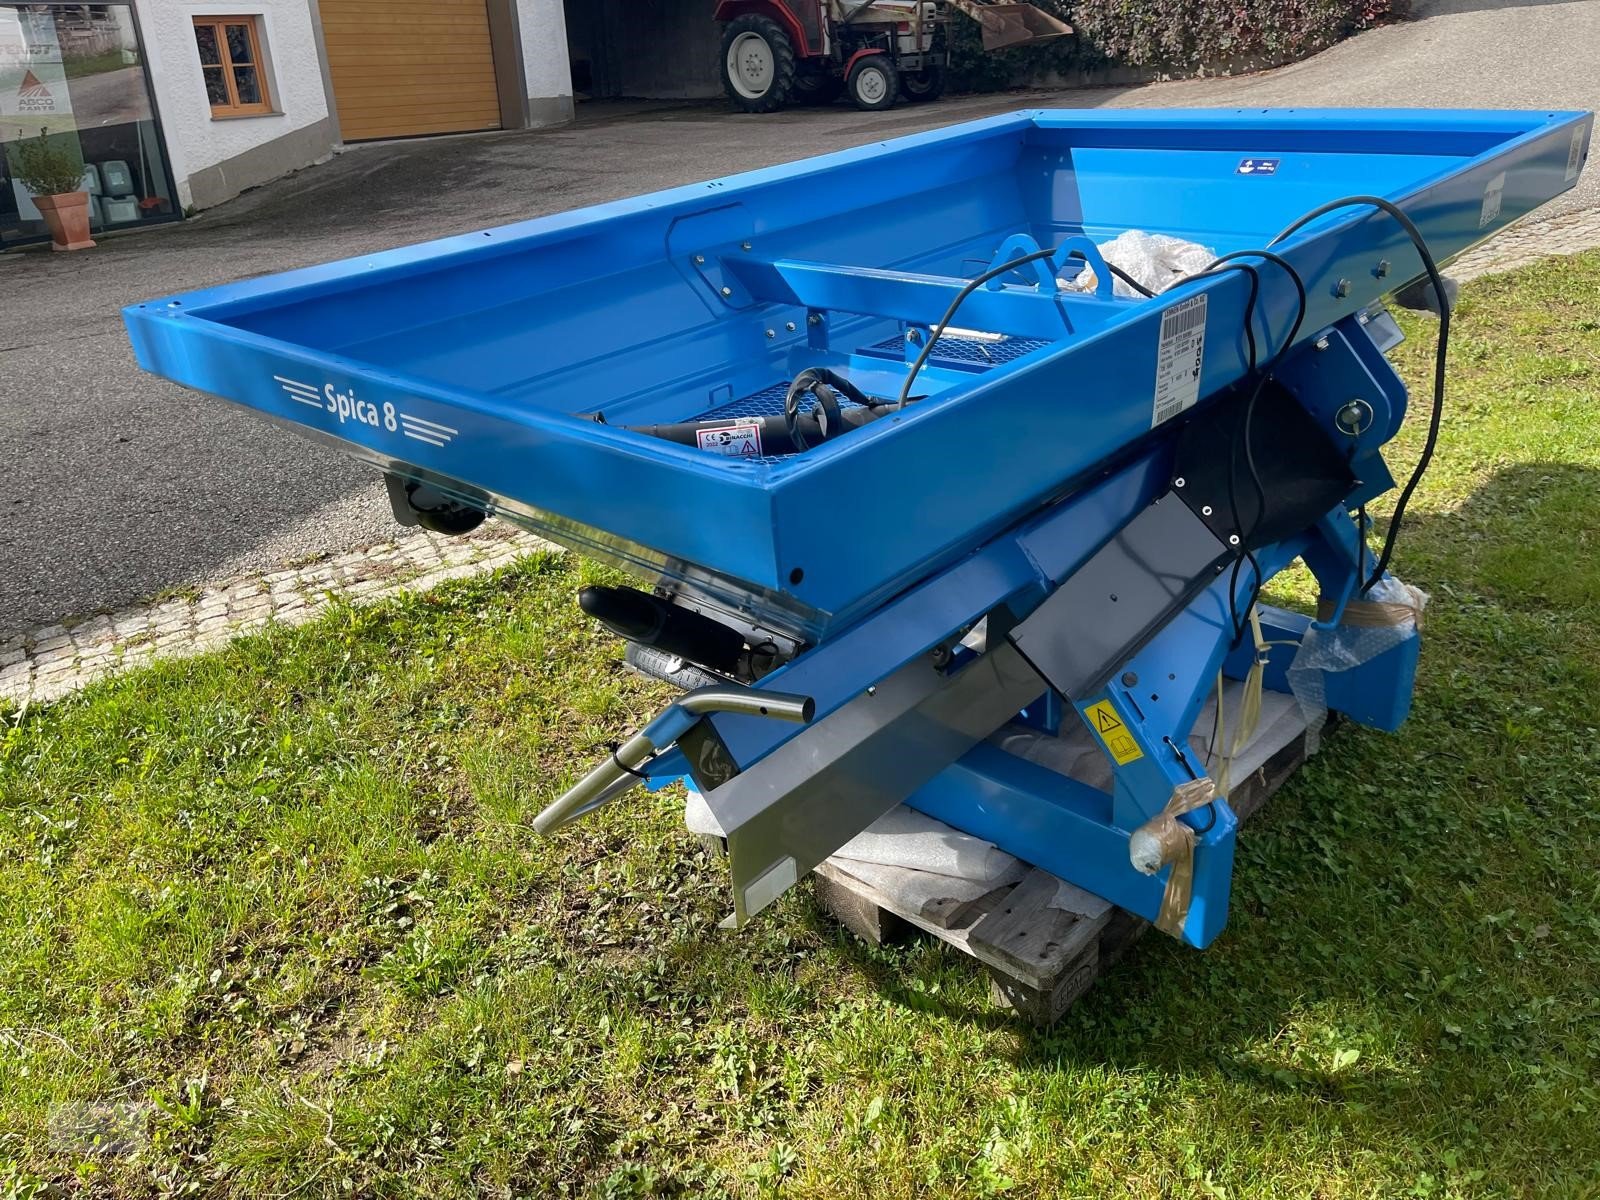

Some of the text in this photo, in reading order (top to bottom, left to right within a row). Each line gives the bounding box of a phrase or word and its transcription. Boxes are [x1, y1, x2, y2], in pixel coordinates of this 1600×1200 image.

[19, 98, 55, 106] AGCO
[324, 383, 398, 432] Spica 8
